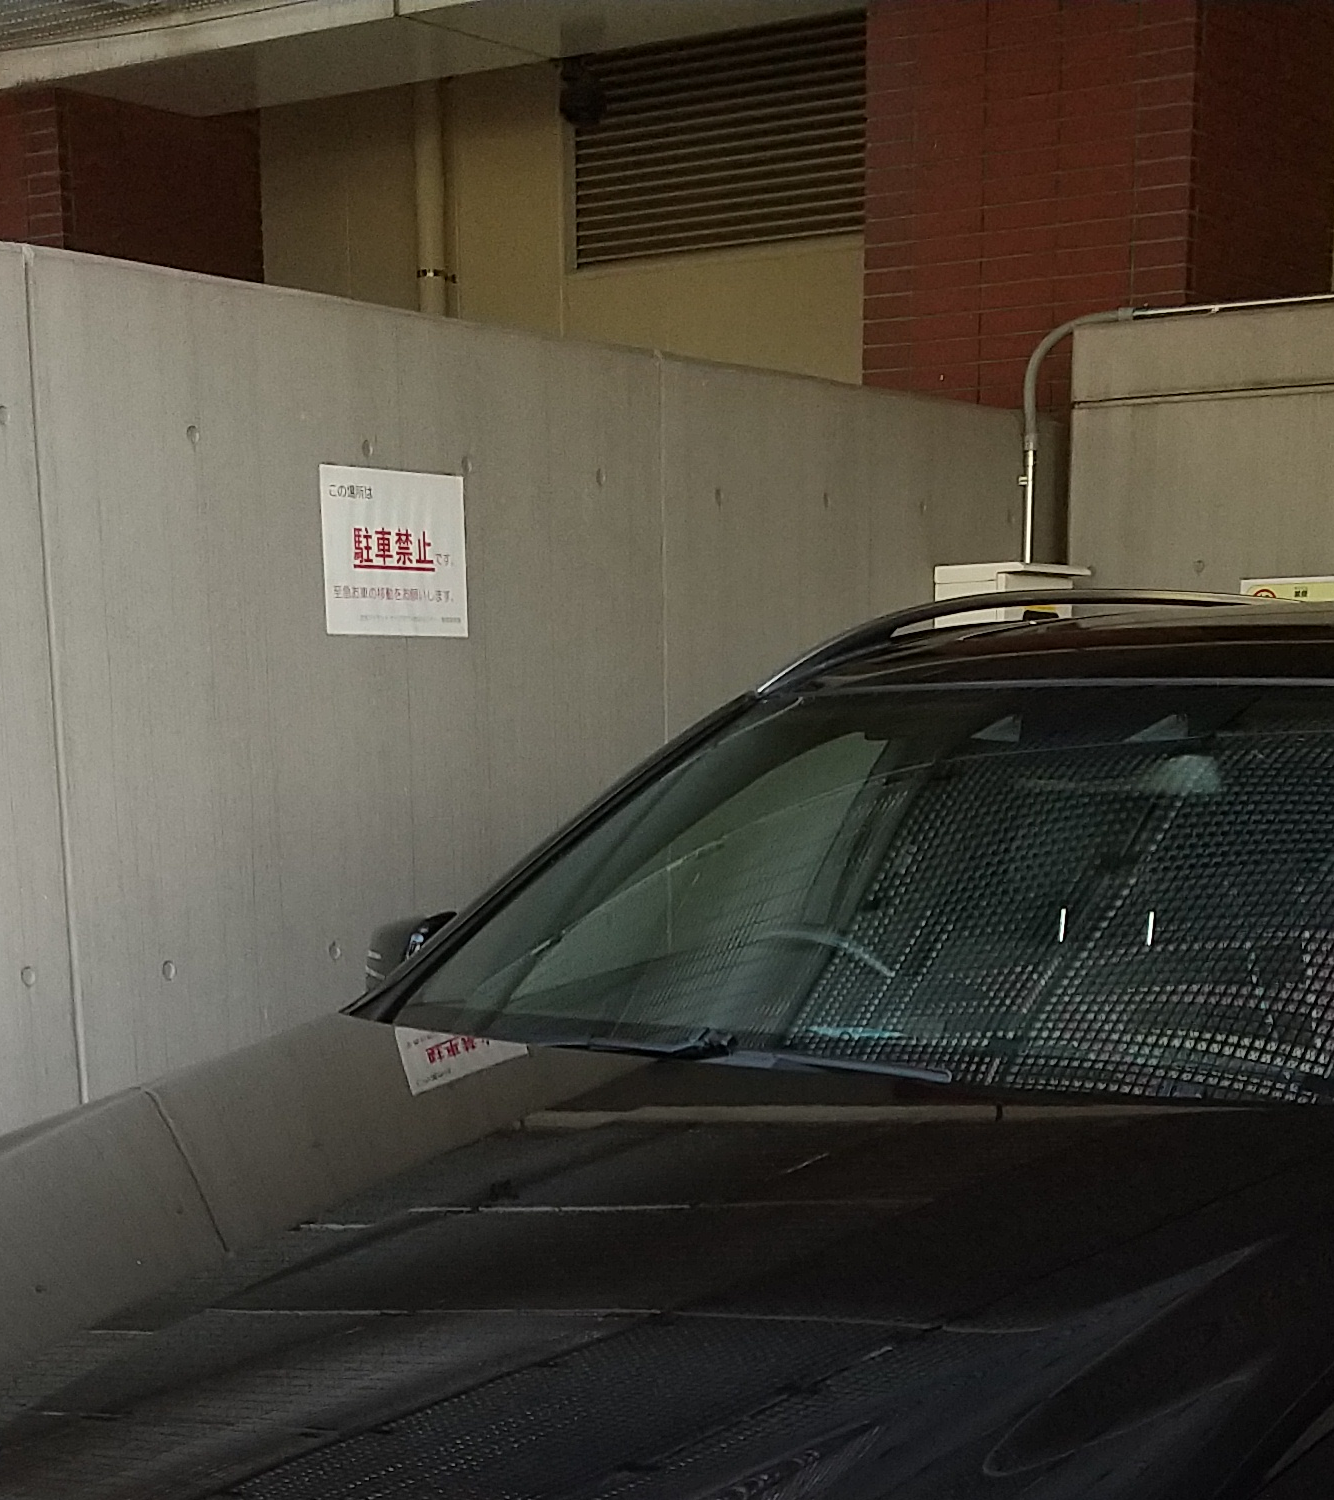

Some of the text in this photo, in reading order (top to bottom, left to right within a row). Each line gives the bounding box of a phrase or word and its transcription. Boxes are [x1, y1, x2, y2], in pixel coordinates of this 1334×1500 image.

[328, 484, 373, 499] この場所は
